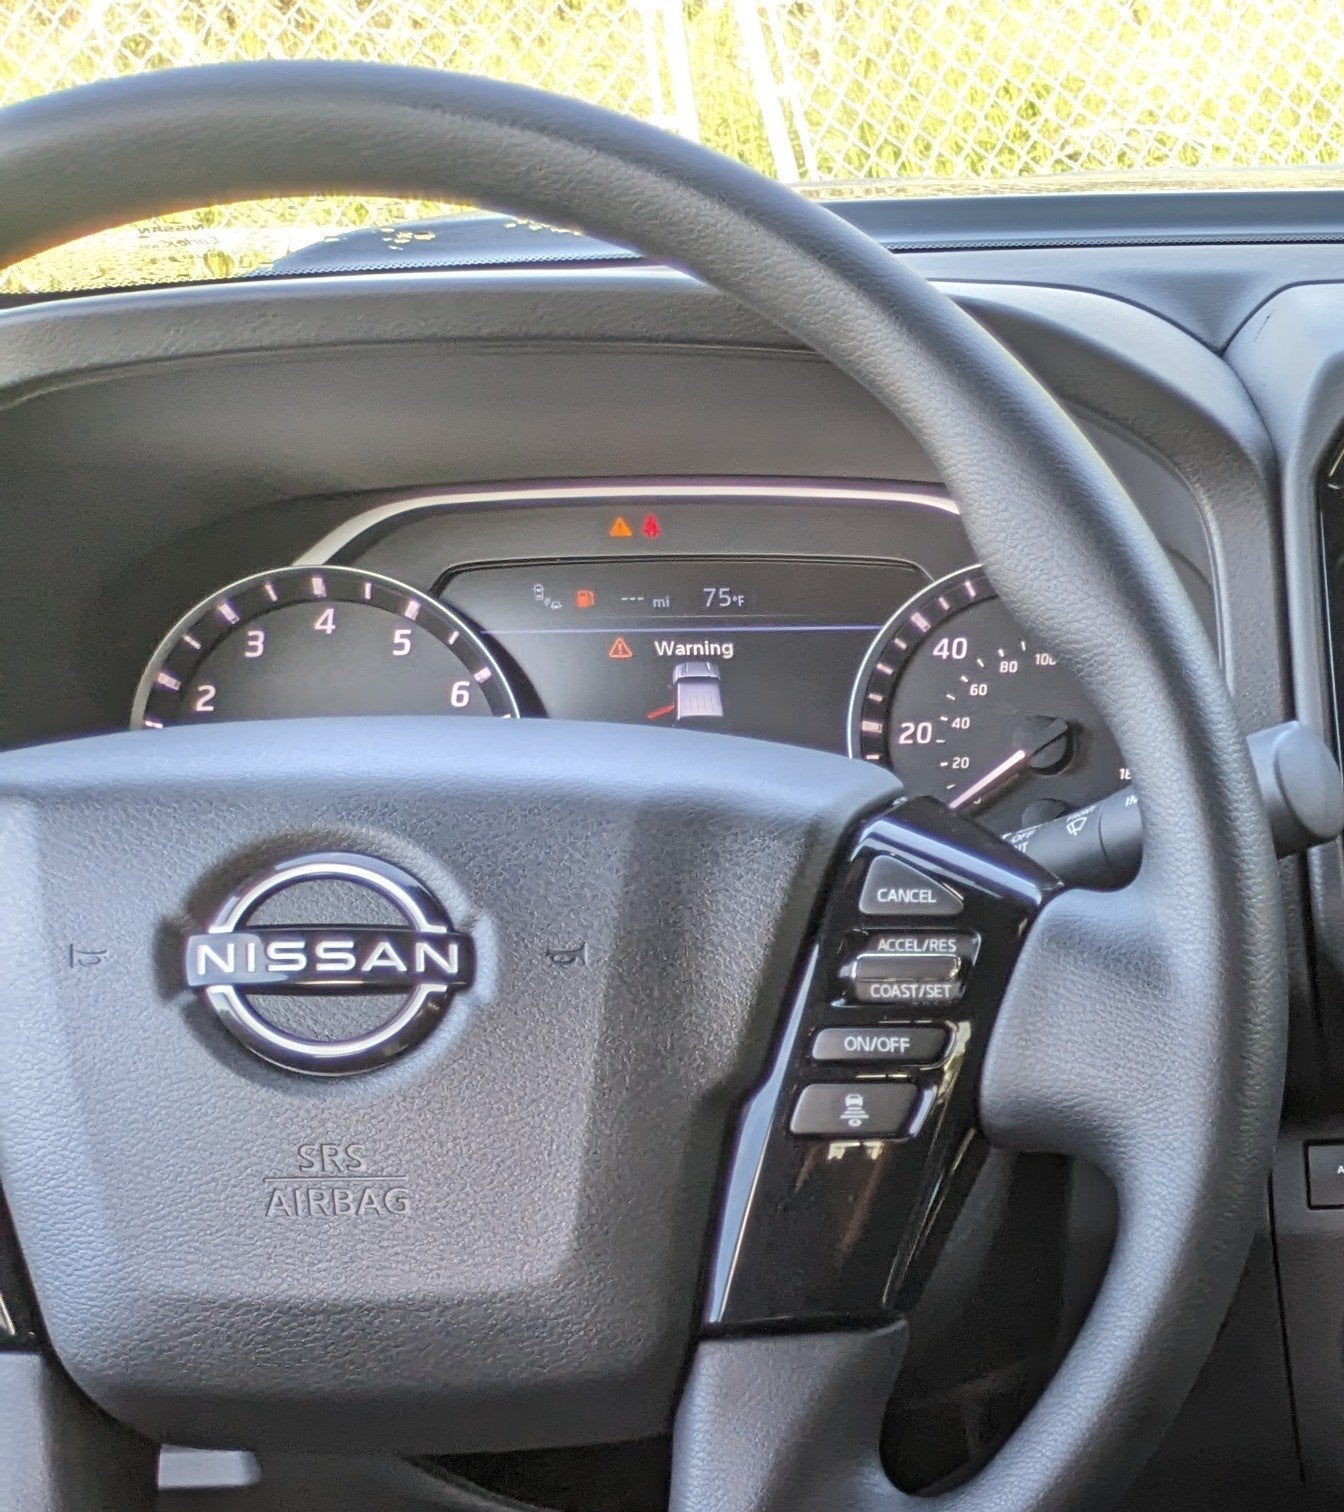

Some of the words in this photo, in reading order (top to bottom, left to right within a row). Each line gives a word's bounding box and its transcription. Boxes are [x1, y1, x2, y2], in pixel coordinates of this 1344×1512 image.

[652, 596, 670, 607] mi
[314, 608, 336, 634] 4
[244, 631, 265, 658] 3
[392, 629, 412, 656] 5
[654, 641, 733, 659] Warning
[933, 638, 967, 659] 40
[1000, 661, 1018, 673] 80
[195, 685, 216, 712] 2
[450, 682, 471, 708] 6
[970, 684, 987, 696] 60
[952, 717, 970, 729] 40
[899, 722, 932, 744] 20
[952, 757, 969, 769] 20
[878, 889, 936, 903] CANCEL
[878, 939, 956, 951] ACCEL/RES
[198, 941, 459, 974] NISSAN
[871, 985, 951, 998] COAST/SET
[845, 1037, 910, 1052] ON/OFF
[298, 1144, 368, 1173] SRS
[264, 1187, 410, 1217] AIRBAG
